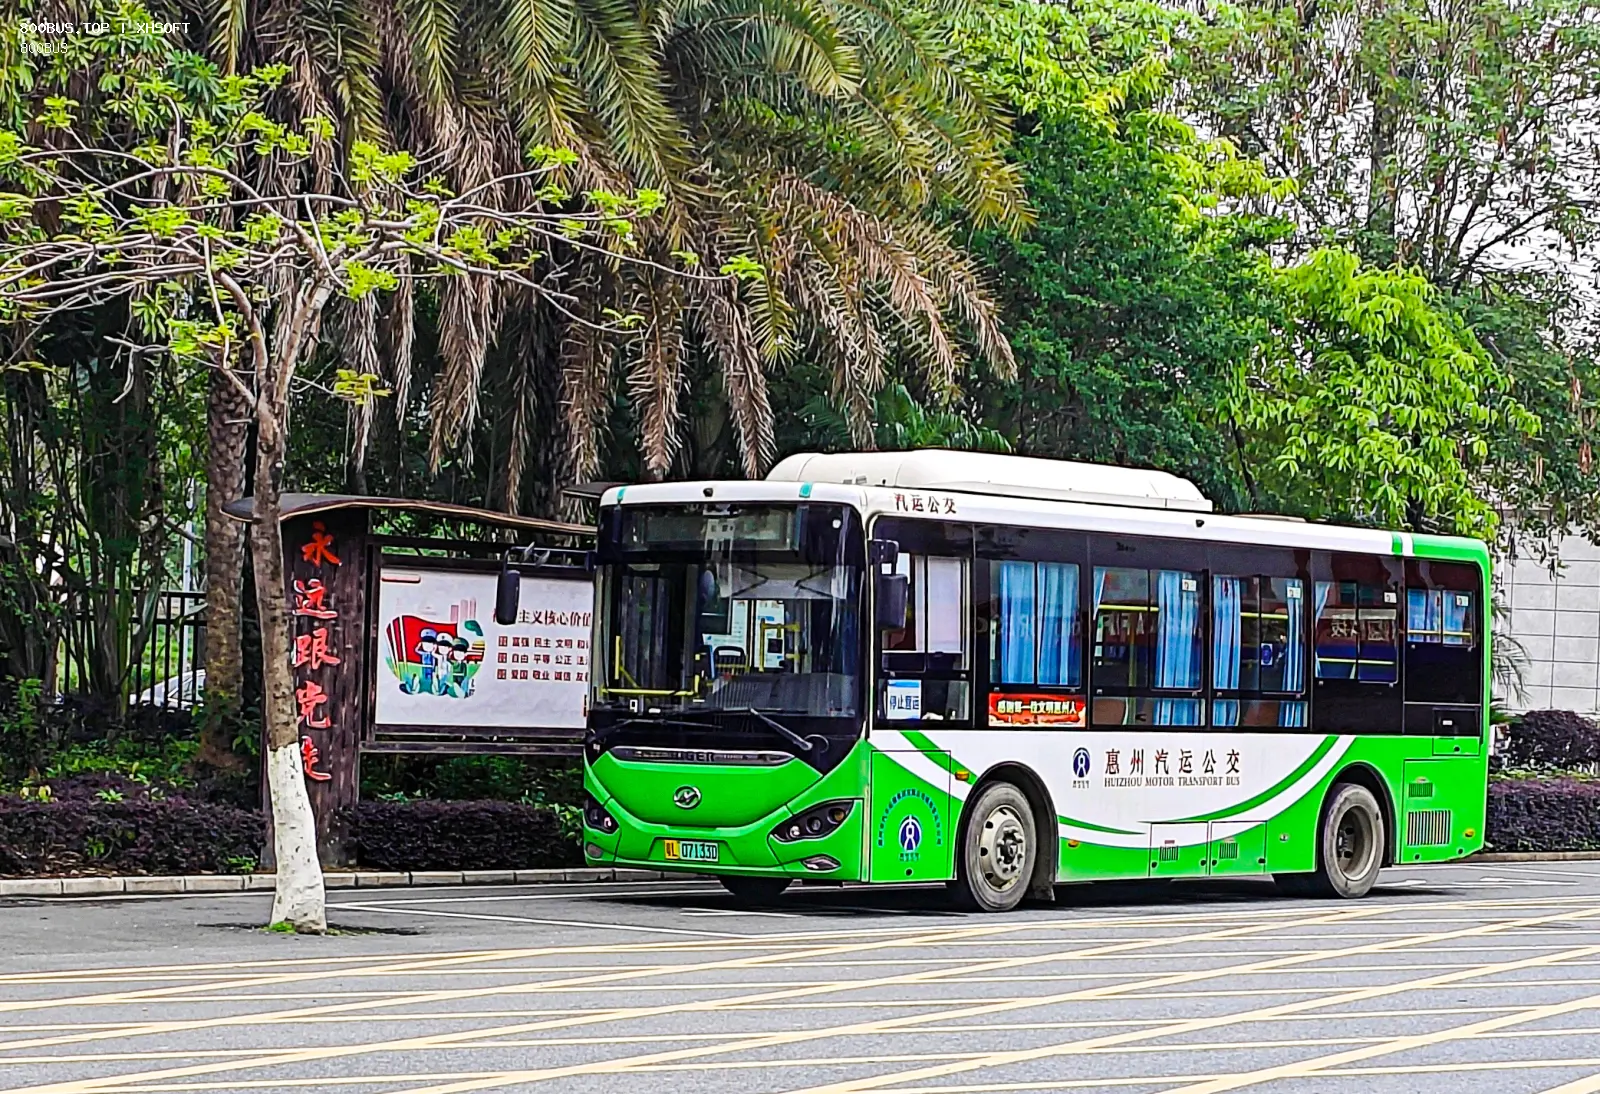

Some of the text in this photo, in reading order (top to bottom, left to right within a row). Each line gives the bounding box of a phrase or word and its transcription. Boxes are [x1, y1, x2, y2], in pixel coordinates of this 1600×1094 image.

[893, 492, 957, 514] 汽运公交
[1105, 748, 1240, 776] 惠州汽运公交
[1104, 776, 1240, 788] HUIZHOU MOTOR TRANSPORT BUS
